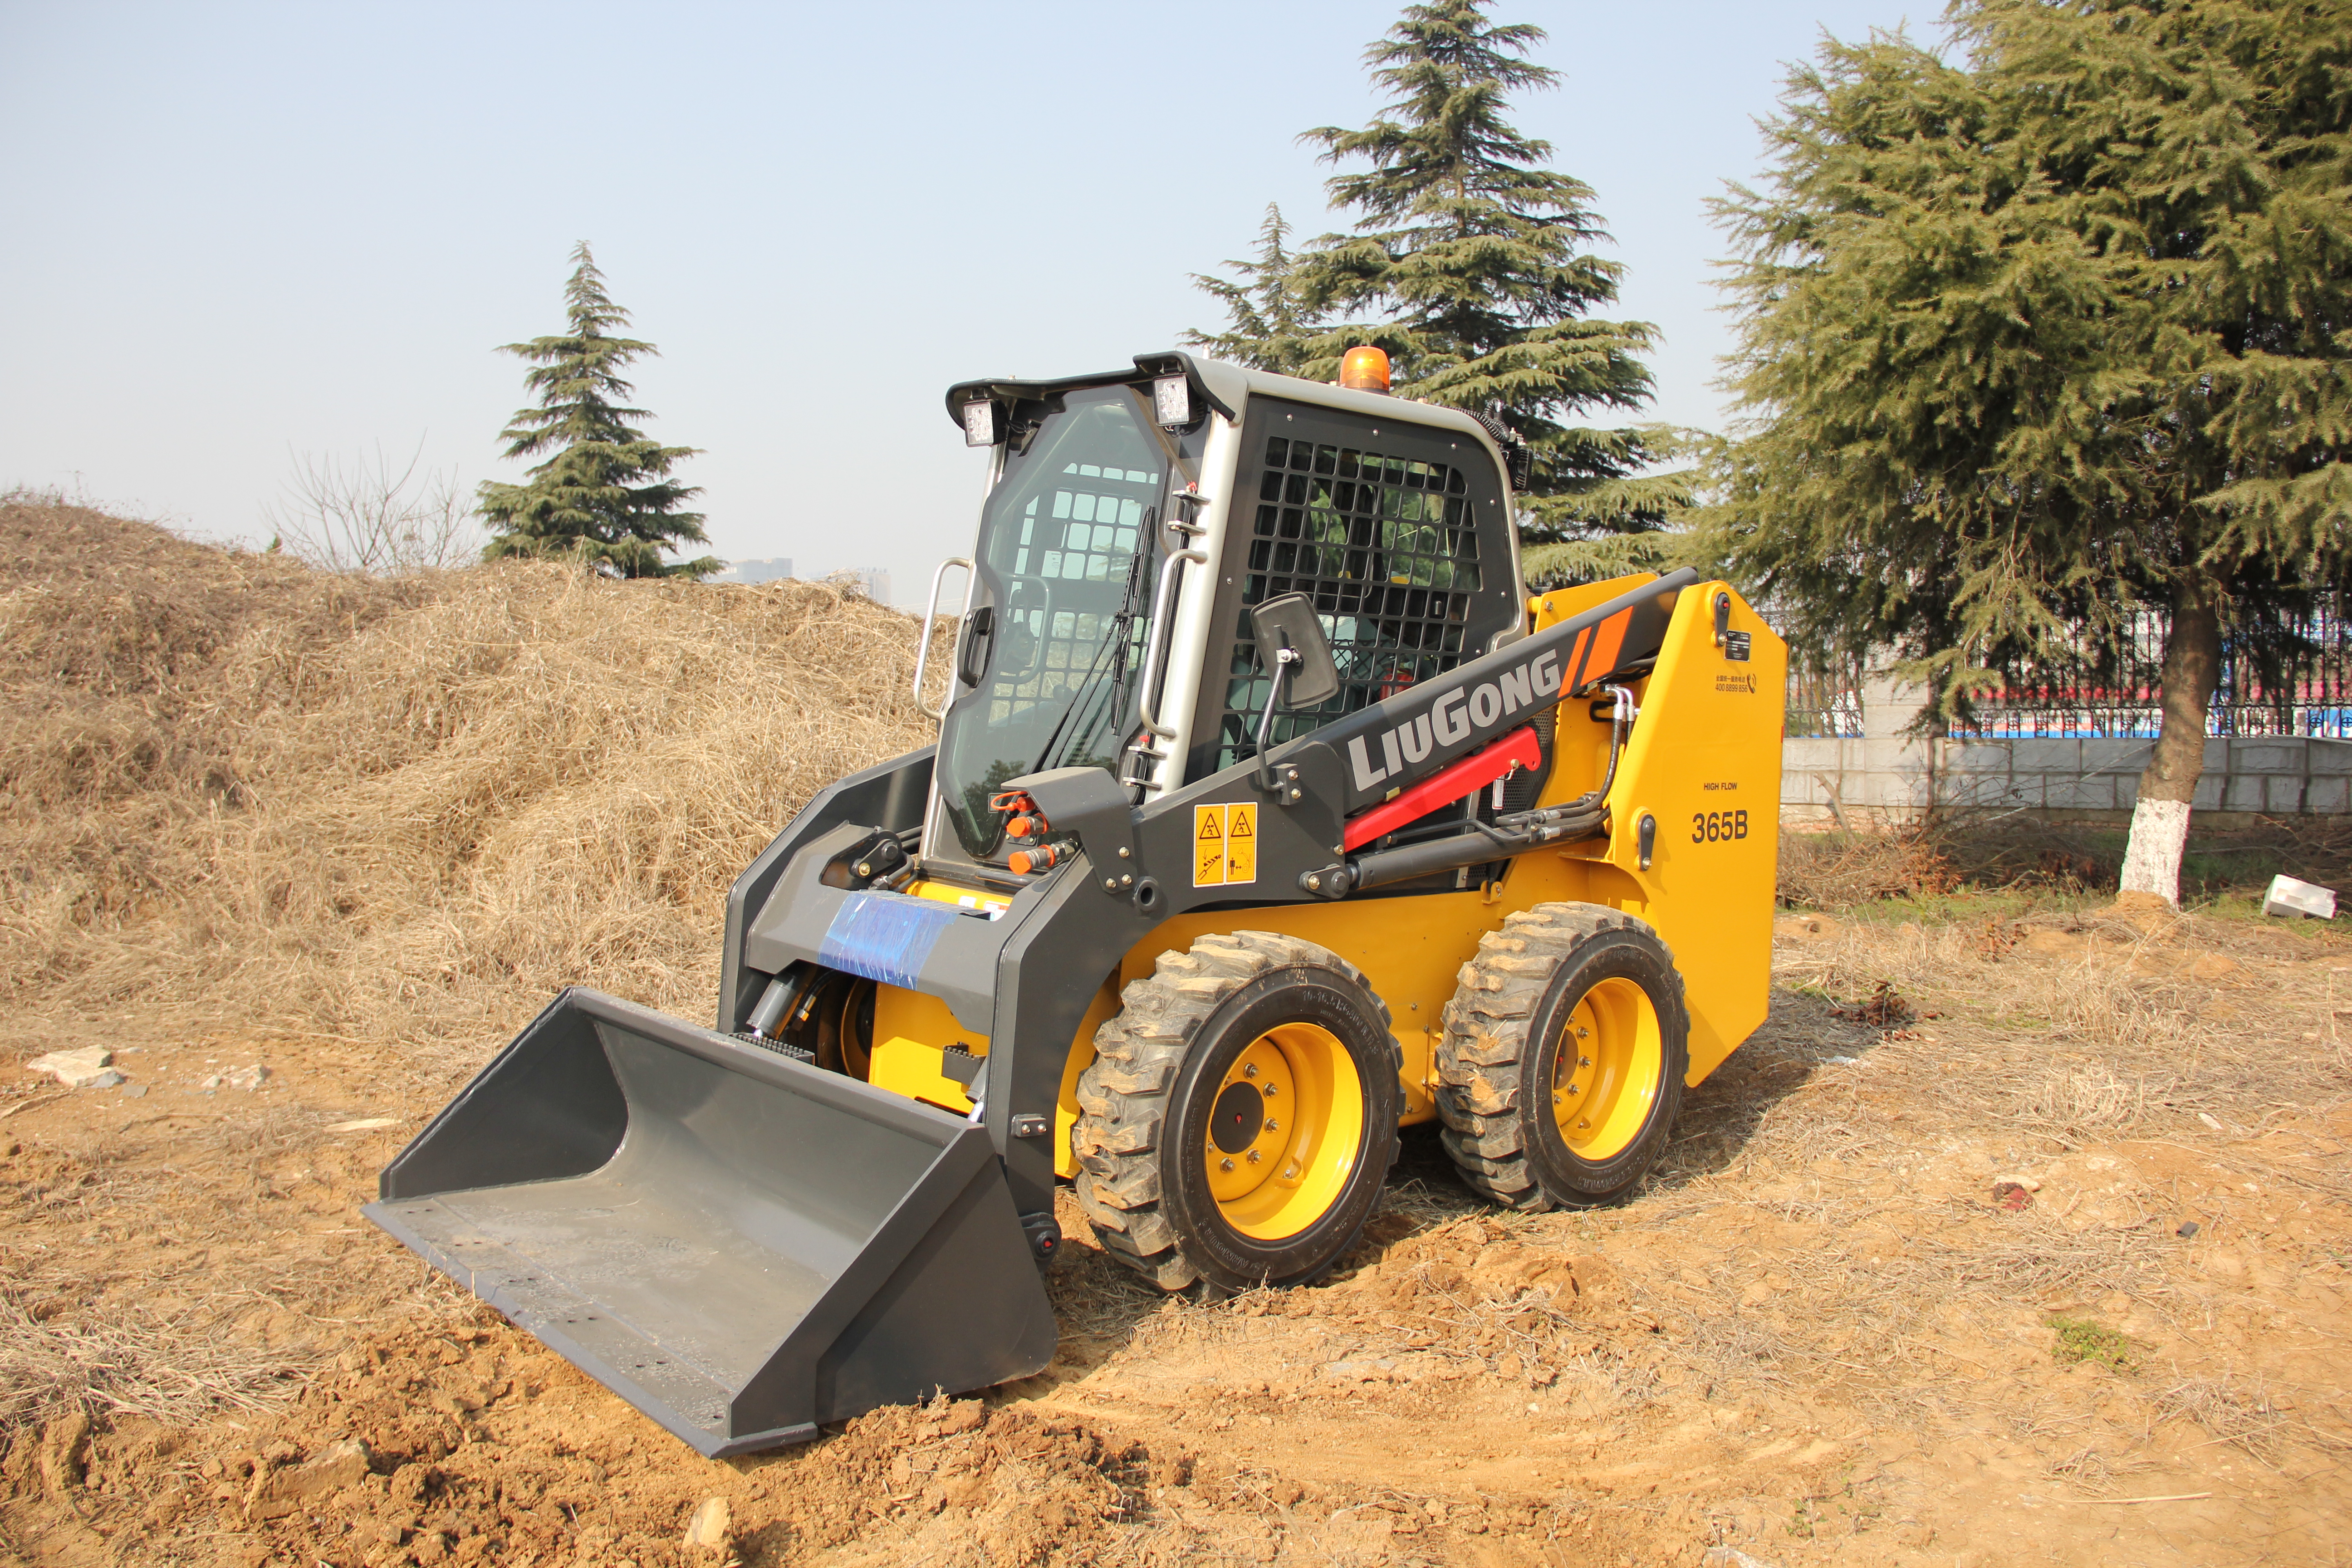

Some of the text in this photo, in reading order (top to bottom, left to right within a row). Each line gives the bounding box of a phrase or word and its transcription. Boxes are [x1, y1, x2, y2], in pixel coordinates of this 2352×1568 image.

[1715, 683, 1748, 692] 400 8899 856
[1348, 648, 1561, 791] LIUGONG
[1692, 809, 1748, 843] 365B
